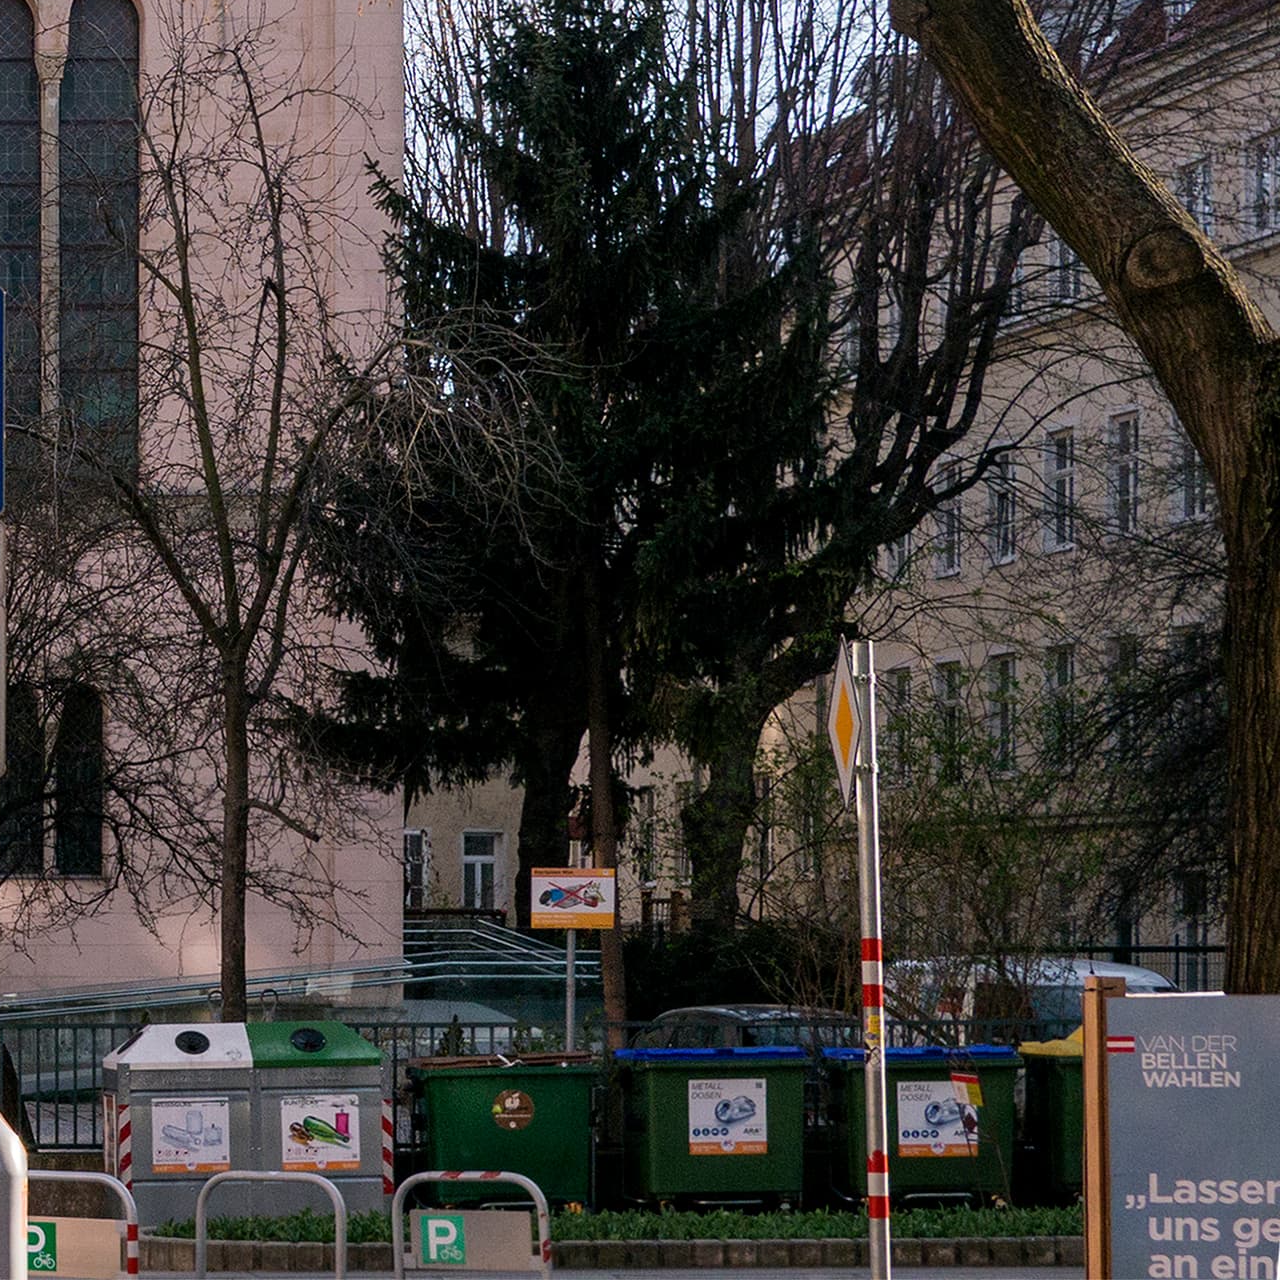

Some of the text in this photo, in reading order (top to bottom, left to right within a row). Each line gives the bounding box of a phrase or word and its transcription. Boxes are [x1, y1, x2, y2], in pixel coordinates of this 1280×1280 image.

[1139, 1035, 1238, 1052] VAN DER
[1141, 1053, 1227, 1069] BELLEN
[691, 1082, 723, 1090] METALL
[900, 1084, 932, 1092] METALL
[900, 1094, 931, 1102] DOSEN
[1148, 1217, 1220, 1242] uns
[427, 1219, 457, 1259] P
[1148, 1253, 1198, 1279] an
